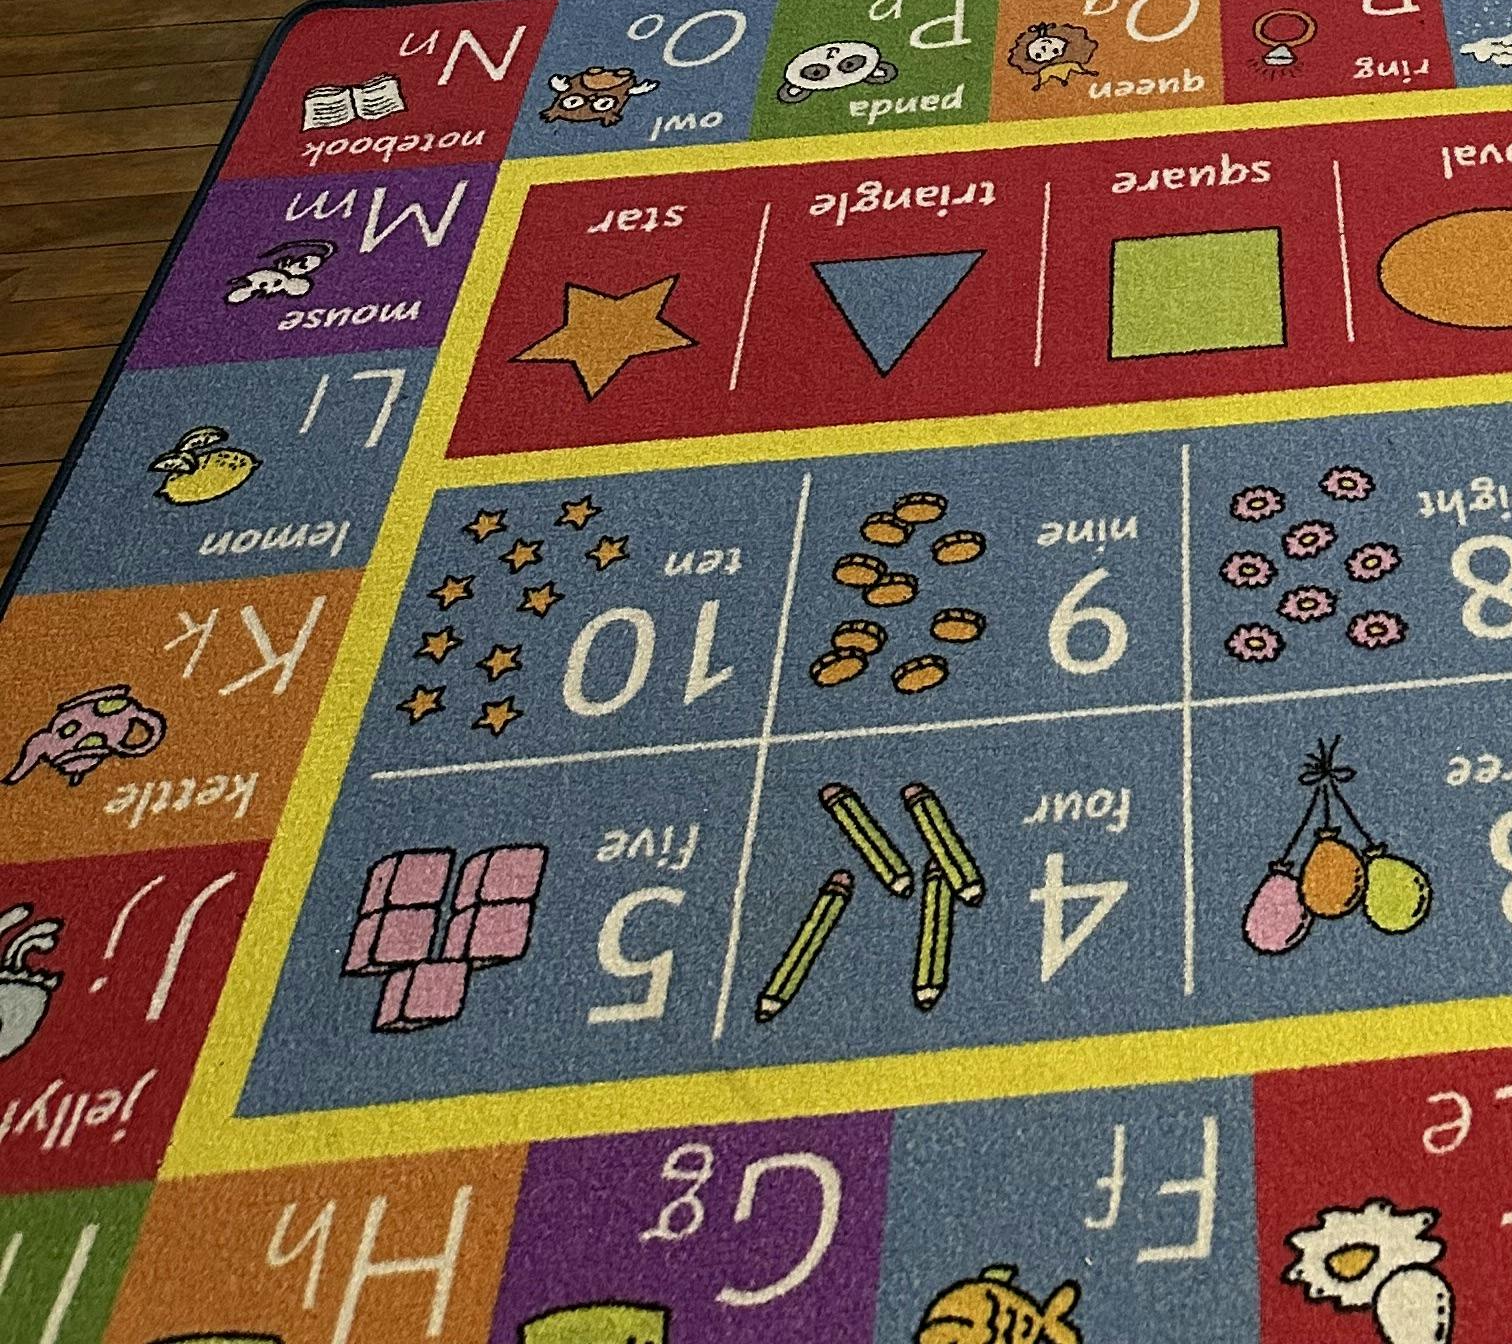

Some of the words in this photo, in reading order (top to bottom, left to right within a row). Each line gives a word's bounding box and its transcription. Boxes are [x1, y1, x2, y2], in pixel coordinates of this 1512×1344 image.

[1089, 69, 1205, 99] queen
[1353, 57, 1428, 83] ring
[850, 84, 964, 125] panda
[649, 112, 723, 141] owl
[302, 130, 485, 166] notebook
[1112, 154, 1270, 193] square
[587, 205, 686, 233] star
[810, 181, 995, 226] triangle
[278, 301, 421, 330] mouse
[199, 521, 350, 557] lemon
[1037, 516, 1137, 553] nine
[664, 548, 741, 577] ten
[1048, 568, 1128, 675] 9
[562, 600, 733, 717] 10
[104, 772, 259, 829] kettle
[1023, 788, 1130, 834] four
[596, 824, 699, 871] five
[1029, 853, 1128, 983] 4
[587, 886, 686, 1025] 5
